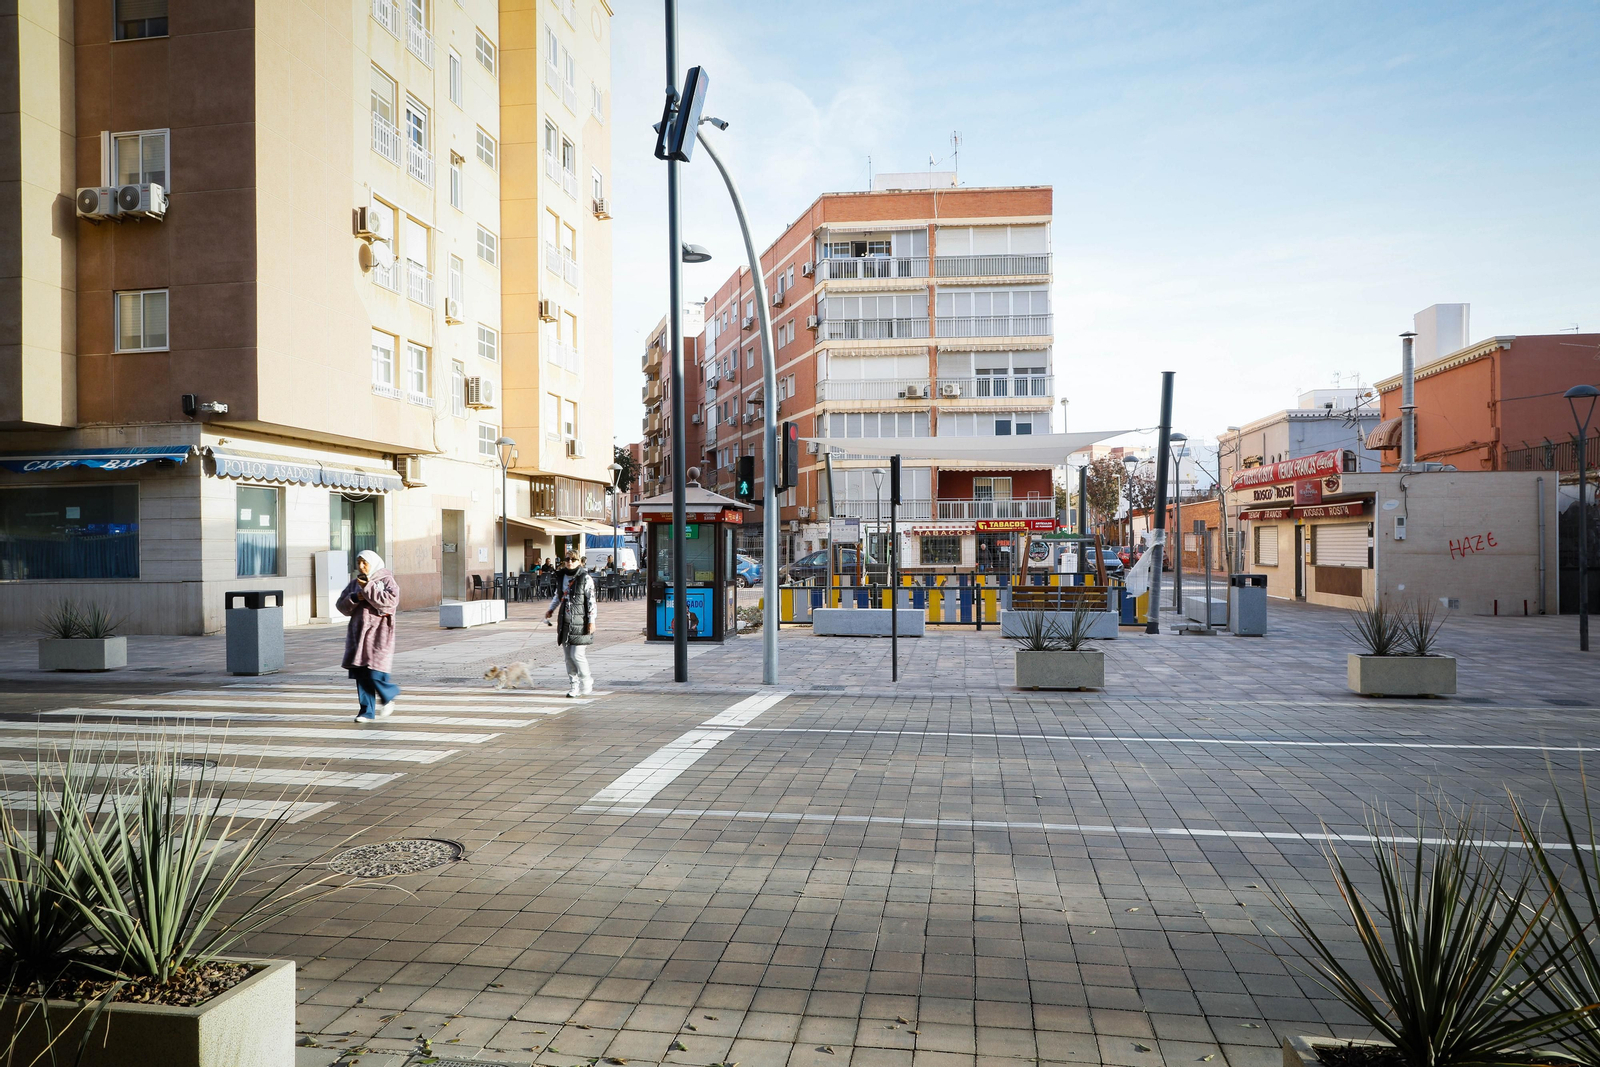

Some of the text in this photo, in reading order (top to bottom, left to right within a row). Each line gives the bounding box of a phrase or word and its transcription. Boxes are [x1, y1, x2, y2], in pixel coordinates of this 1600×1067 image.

[100, 459, 148, 469] BAR
[223, 459, 314, 480] POLLOS ASADOS
[1278, 456, 1317, 480] TIENDA FRANCIS
[368, 475, 384, 488] BAR
[1253, 486, 1294, 501] KIOSCO ROSIT
[1264, 510, 1283, 519] FRANCIS
[1303, 506, 1350, 517] KIOSCO ROSITA
[1449, 532, 1498, 560] HAZE
